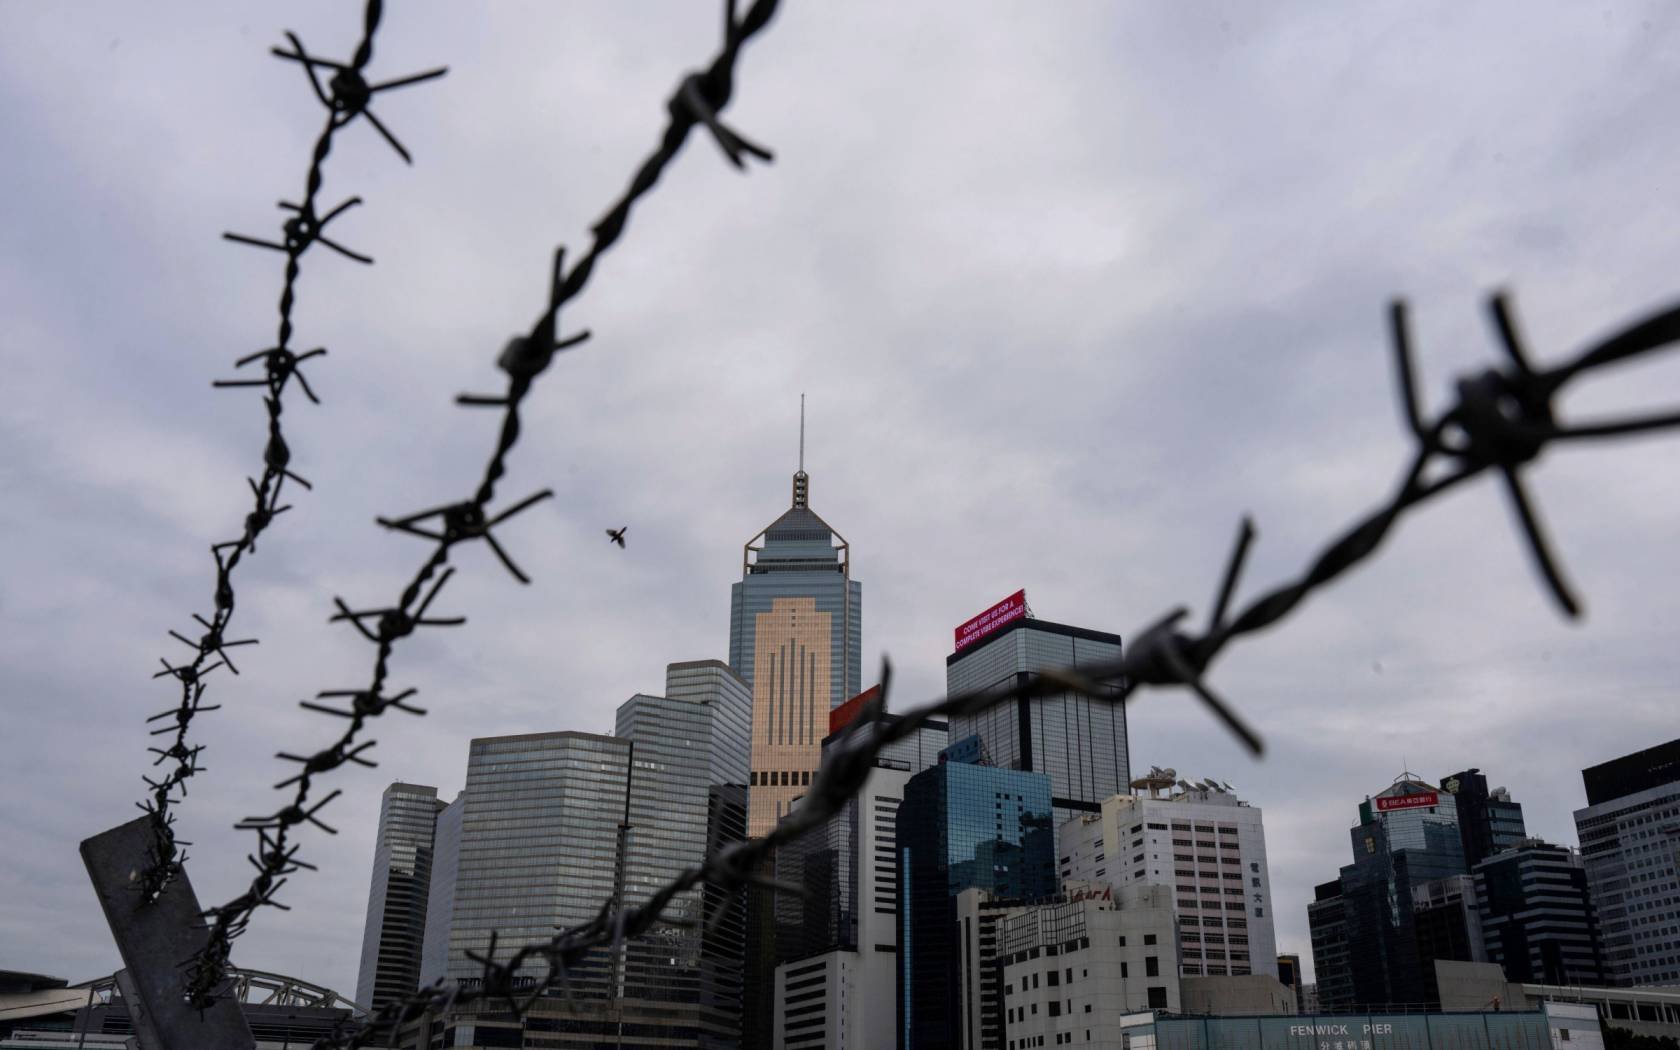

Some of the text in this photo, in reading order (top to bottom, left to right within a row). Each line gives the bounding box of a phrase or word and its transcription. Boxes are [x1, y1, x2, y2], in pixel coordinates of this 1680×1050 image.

[963, 620, 978, 634] COME
[979, 614, 990, 625] VISIT
[991, 609, 998, 618] US
[998, 603, 1009, 614] FOR
[956, 630, 980, 649] COMPLETE
[1290, 1023, 1392, 1036] FENWICK PIER
